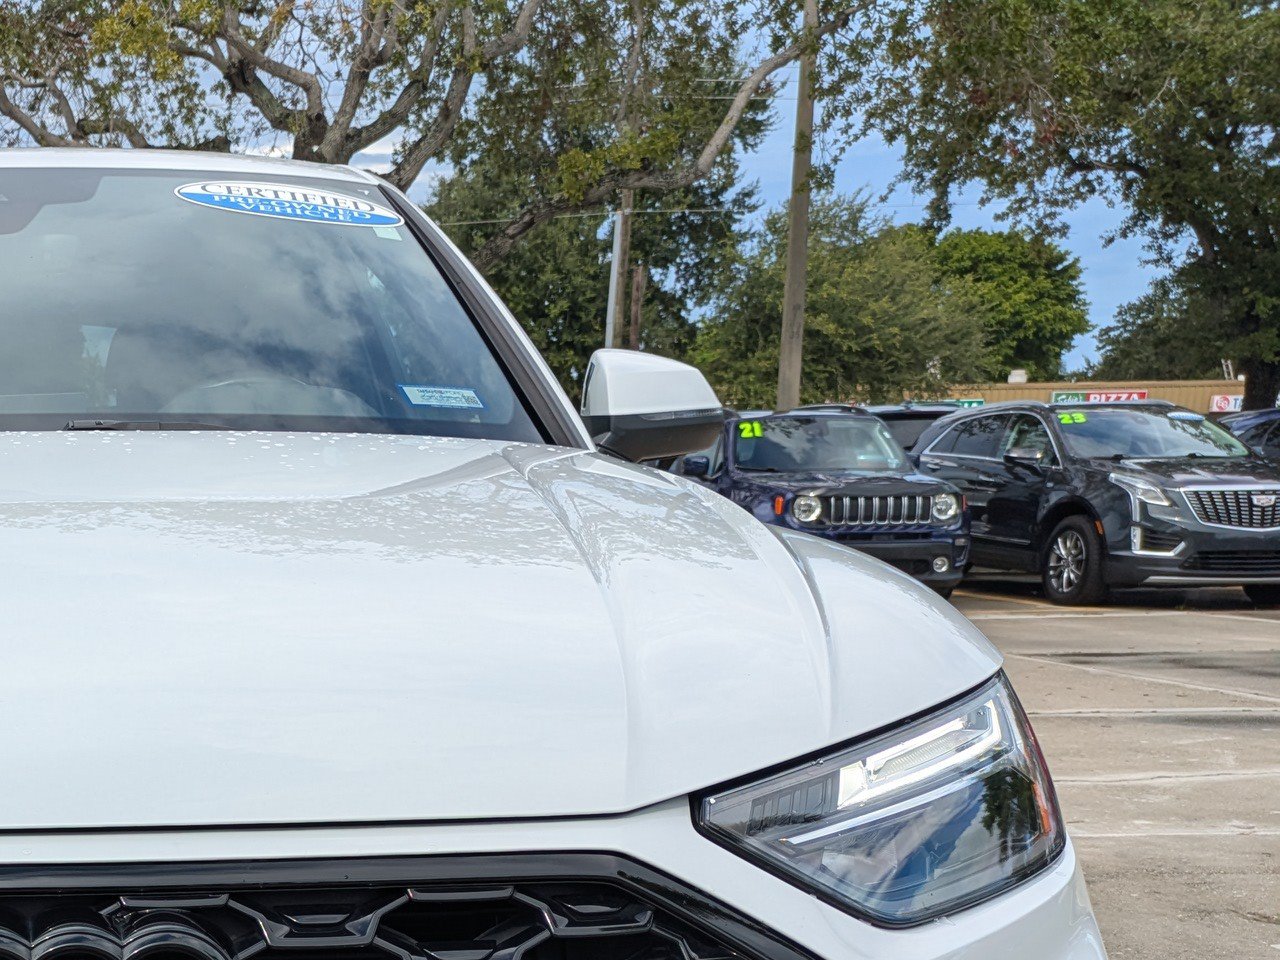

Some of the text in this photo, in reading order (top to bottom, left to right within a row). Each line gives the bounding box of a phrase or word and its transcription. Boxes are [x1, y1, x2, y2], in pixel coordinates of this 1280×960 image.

[200, 184, 376, 212] CERTIFIED
[212, 195, 372, 219] PRE-OWNED
[238, 203, 353, 222] VEHICLE
[1089, 392, 1139, 403] PIZZA
[1057, 412, 1087, 425] 23
[739, 421, 763, 438] 21
